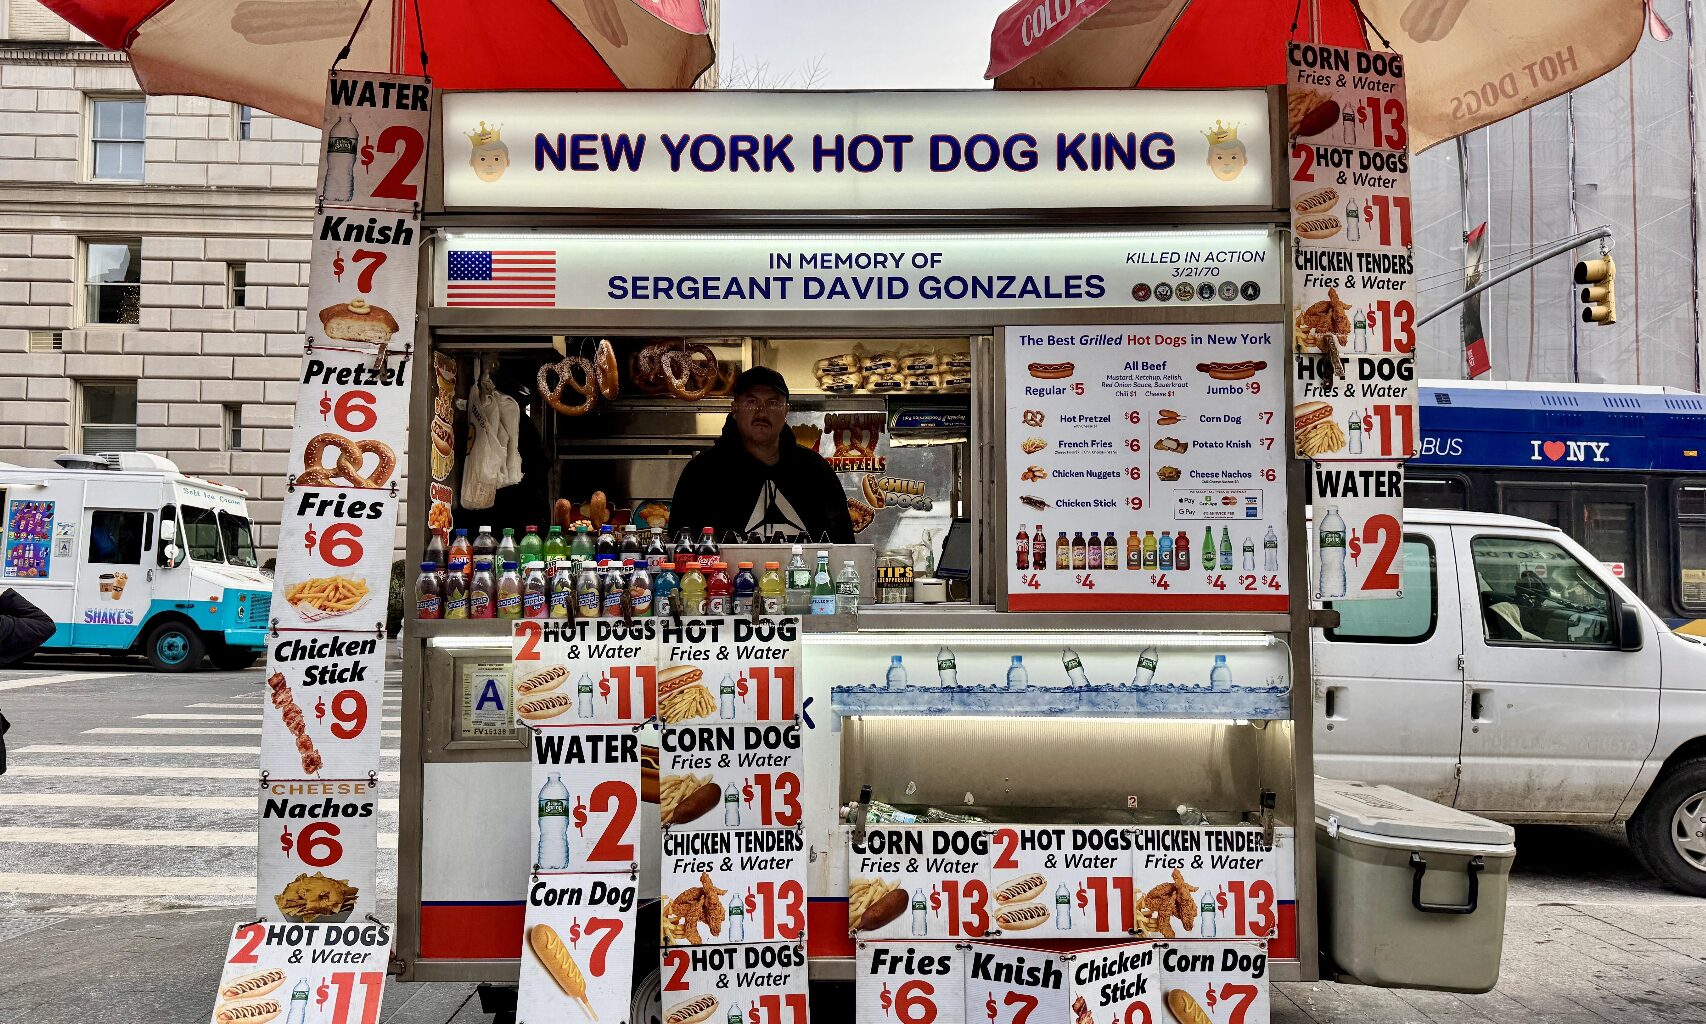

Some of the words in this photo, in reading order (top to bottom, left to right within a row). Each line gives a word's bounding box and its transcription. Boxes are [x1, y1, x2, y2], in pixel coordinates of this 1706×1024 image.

[1289, 44, 1349, 72] CORN
[1357, 52, 1403, 78] DOG
[330, 79, 429, 111] WATER
[1298, 70, 1330, 86] Fries
[1336, 74, 1347, 87] &
[1353, 76, 1395, 93] Water
[1357, 97, 1406, 150] $13
[360, 125, 424, 200] $2
[534, 132, 646, 172] NEW
[661, 133, 795, 173] YORK
[812, 133, 913, 173] HOT
[930, 133, 1038, 172] DOG
[1056, 131, 1175, 172] KING
[1292, 144, 1315, 182] 2
[1316, 147, 1353, 168] HOT
[1359, 151, 1408, 173] DOGS
[320, 216, 414, 245] Knish
[1363, 195, 1412, 246] $11
[769, 253, 791, 269] IN
[800, 253, 905, 269] MEMORY
[911, 252, 943, 269] OF
[1126, 252, 1181, 264] KILLED
[1185, 251, 1201, 264] IN
[1204, 250, 1266, 263] ACTION
[1295, 251, 1353, 272] CHICKEN
[1357, 253, 1414, 275] TENDERS
[333, 249, 387, 293] $7
[1172, 266, 1220, 277] 3/21/70
[607, 276, 793, 300] SERGEANT
[803, 276, 908, 300] DAVID
[918, 274, 1105, 299] GONZALES
[1367, 300, 1415, 353] $13
[1019, 335, 1044, 346] The
[1047, 335, 1075, 346] Best
[1079, 334, 1122, 346] Grilled
[1127, 334, 1150, 345] Hot
[1155, 334, 1187, 348] Dogs
[1191, 334, 1203, 345] in
[1207, 334, 1238, 345] New
[1241, 333, 1271, 345] York
[303, 359, 405, 387] Pretzel
[1123, 361, 1140, 371] All
[1143, 361, 1167, 371] Beef
[1025, 386, 1066, 397] Regular
[1069, 382, 1085, 396] $5
[1206, 385, 1243, 396] Jumbo
[1245, 382, 1261, 395] $9
[320, 390, 377, 432] $6
[1060, 414, 1077, 423] Hot
[1079, 413, 1111, 423] Pretzel
[1124, 411, 1140, 424] $6
[1199, 414, 1221, 423] Corn
[1224, 414, 1241, 425] Dog
[1258, 412, 1274, 424] $7
[1058, 440, 1087, 449] French
[1091, 440, 1113, 448] Fries
[1124, 438, 1140, 452] $6
[1192, 440, 1222, 448] Potato
[1225, 440, 1251, 449] Knish
[1259, 438, 1274, 451] $7
[1531, 441, 1542, 461] I
[879, 477, 925, 494] CHILI
[1052, 469, 1084, 478] Chicken
[1086, 469, 1121, 481] Nuggets
[1124, 467, 1140, 480] $6
[1189, 470, 1218, 479] Cheese
[1221, 470, 1252, 479] Nachos
[1260, 469, 1276, 482] $6
[1316, 471, 1401, 498] WATER
[297, 492, 384, 519] Fries
[885, 493, 933, 511] DOGS
[1055, 499, 1088, 508] Chicken
[1090, 499, 1117, 508] Stick
[1125, 497, 1142, 510] $9
[304, 523, 363, 567] $6
[1349, 514, 1401, 591] $2
[877, 566, 914, 579] TIPS
[1021, 574, 1041, 590] $4
[1075, 574, 1095, 590] $4
[1150, 574, 1170, 590] $4
[1206, 574, 1226, 590] $4
[1238, 574, 1257, 590] $2
[1262, 574, 1281, 590] $4
[84, 608, 134, 625] SHAKES
[514, 620, 542, 660] 2
[543, 621, 589, 642] HOT
[597, 619, 656, 641] DOGS
[662, 619, 724, 644] HOT
[734, 618, 797, 643] DOG
[274, 635, 376, 662] Chicken
[567, 645, 581, 659] &
[587, 644, 641, 660] Water
[302, 661, 368, 687] Stick
[475, 680, 504, 711] A
[599, 666, 656, 719] $11
[736, 666, 795, 721] $11
[315, 689, 367, 740] $9
[535, 734, 639, 765] WATER
[661, 726, 734, 753] CORN
[744, 724, 800, 751] DOG
[272, 783, 366, 796] CHEESE
[742, 771, 802, 826] $13
[263, 799, 373, 819] Nachos
[573, 780, 638, 861] $2
[280, 822, 343, 867] $6
[932, 830, 988, 856] DOG
[993, 828, 1019, 869] 2
[1021, 829, 1065, 851] HOT
[1072, 829, 1132, 851] DOGS
[530, 881, 582, 907] Corn
[589, 882, 636, 912] Dog
[930, 879, 990, 938] $13
[1076, 877, 1133, 932] $11
[228, 923, 266, 964] 2
[266, 925, 321, 947] HOT
[324, 924, 390, 947] DOGS
[288, 949, 304, 964] &
[310, 948, 371, 965] Water
[570, 916, 624, 977] $7
[870, 948, 952, 976] Fries
[971, 951, 1063, 990] Knish
[1163, 949, 1214, 972] Corn
[1221, 949, 1266, 978] Dog
[317, 972, 384, 1024] $11
[880, 980, 937, 1024] $6
[986, 990, 1038, 1024] $7
[1206, 982, 1258, 1024] $7
